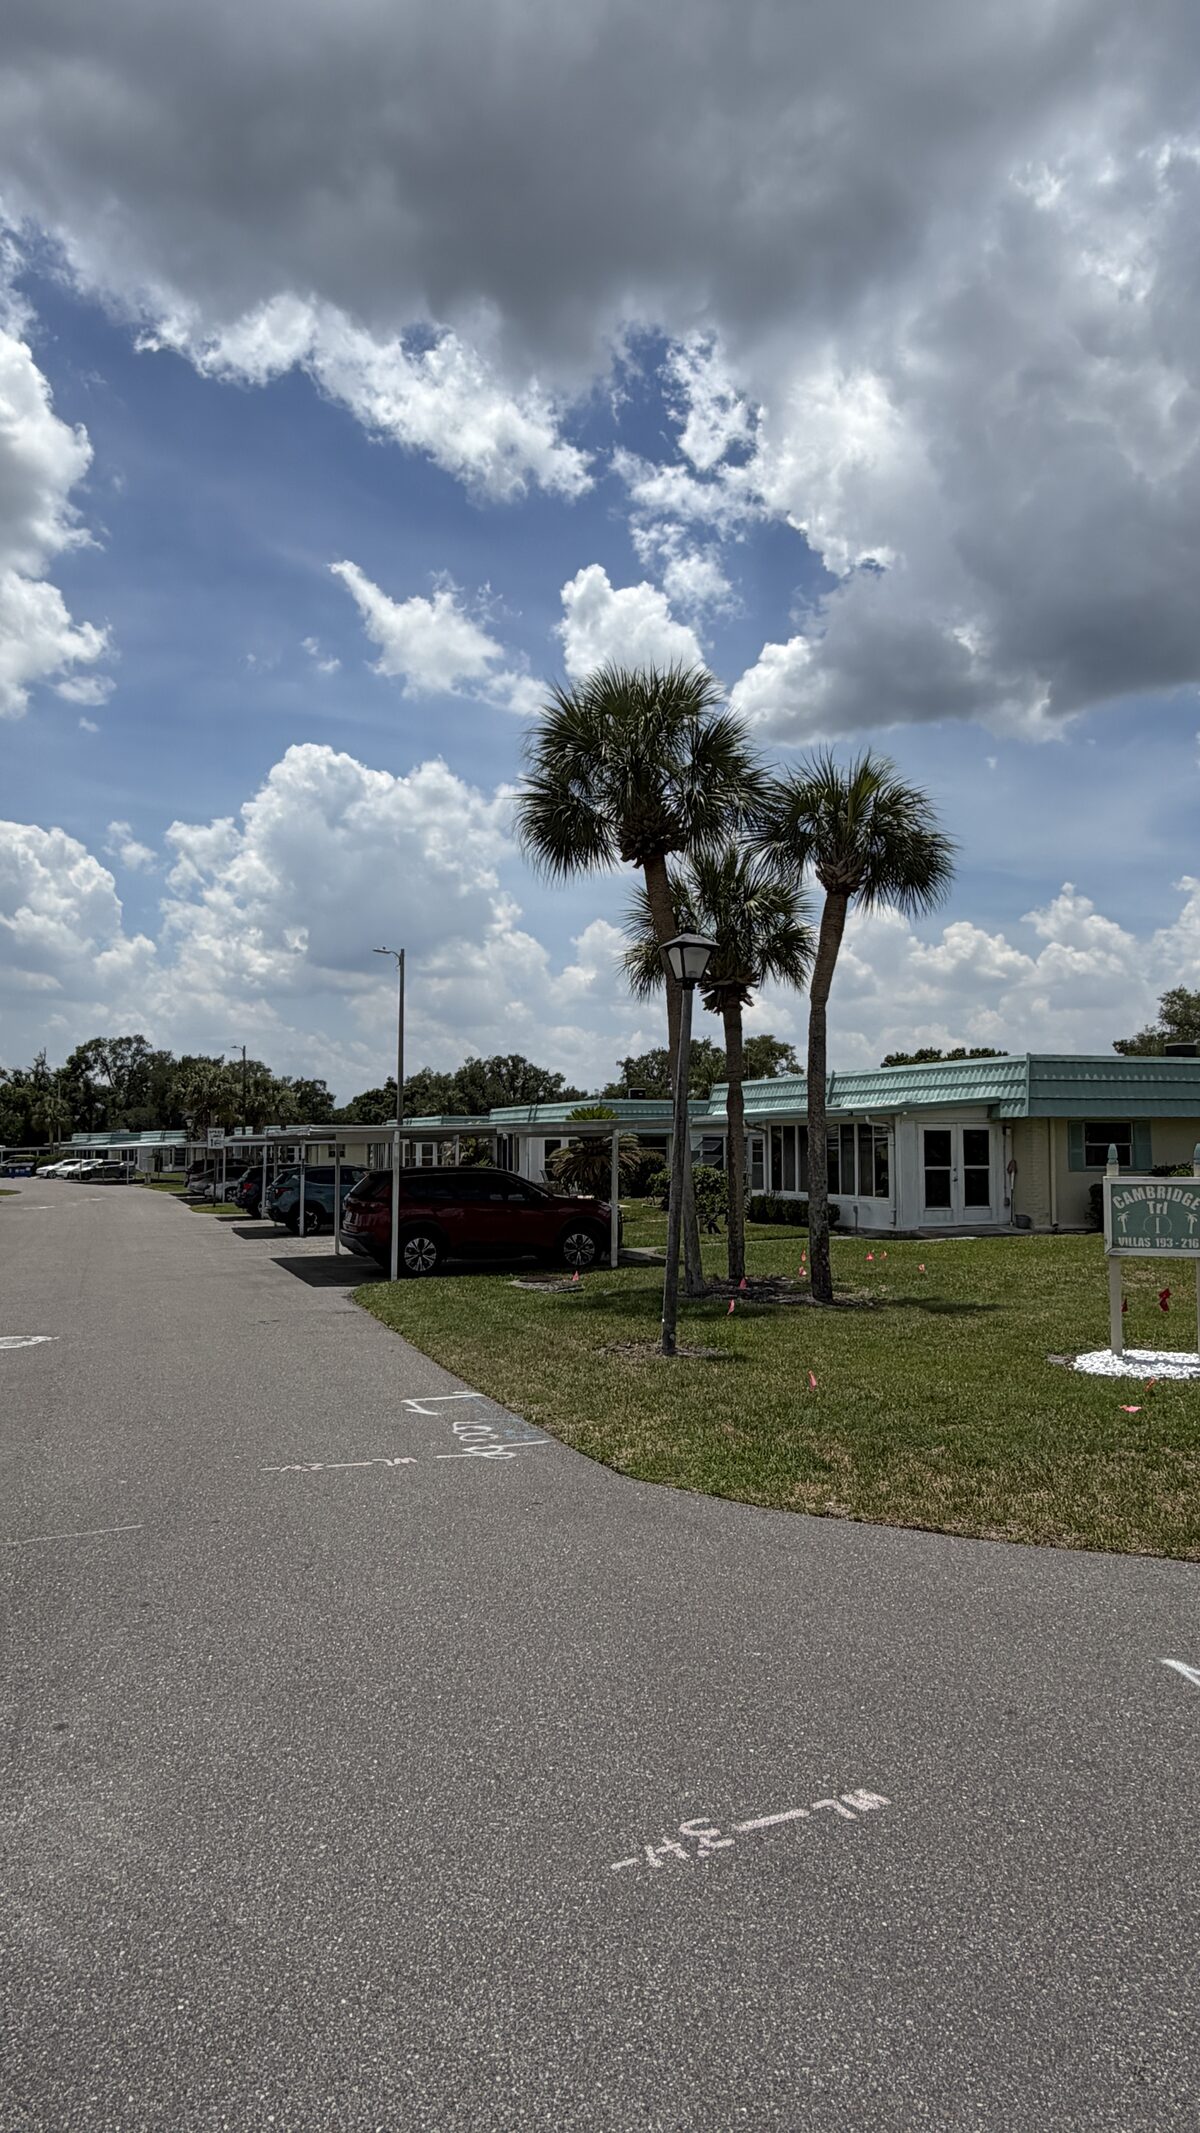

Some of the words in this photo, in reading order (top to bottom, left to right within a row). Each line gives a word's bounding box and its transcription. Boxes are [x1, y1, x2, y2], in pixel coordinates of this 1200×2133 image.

[1112, 1185, 1200, 1211] CAMBRIDGE
[1146, 1201, 1168, 1214] Trl
[1118, 1237, 1151, 1247] VILLAS
[1155, 1237, 1173, 1248] 193
[1180, 1238, 1199, 1248] 216
